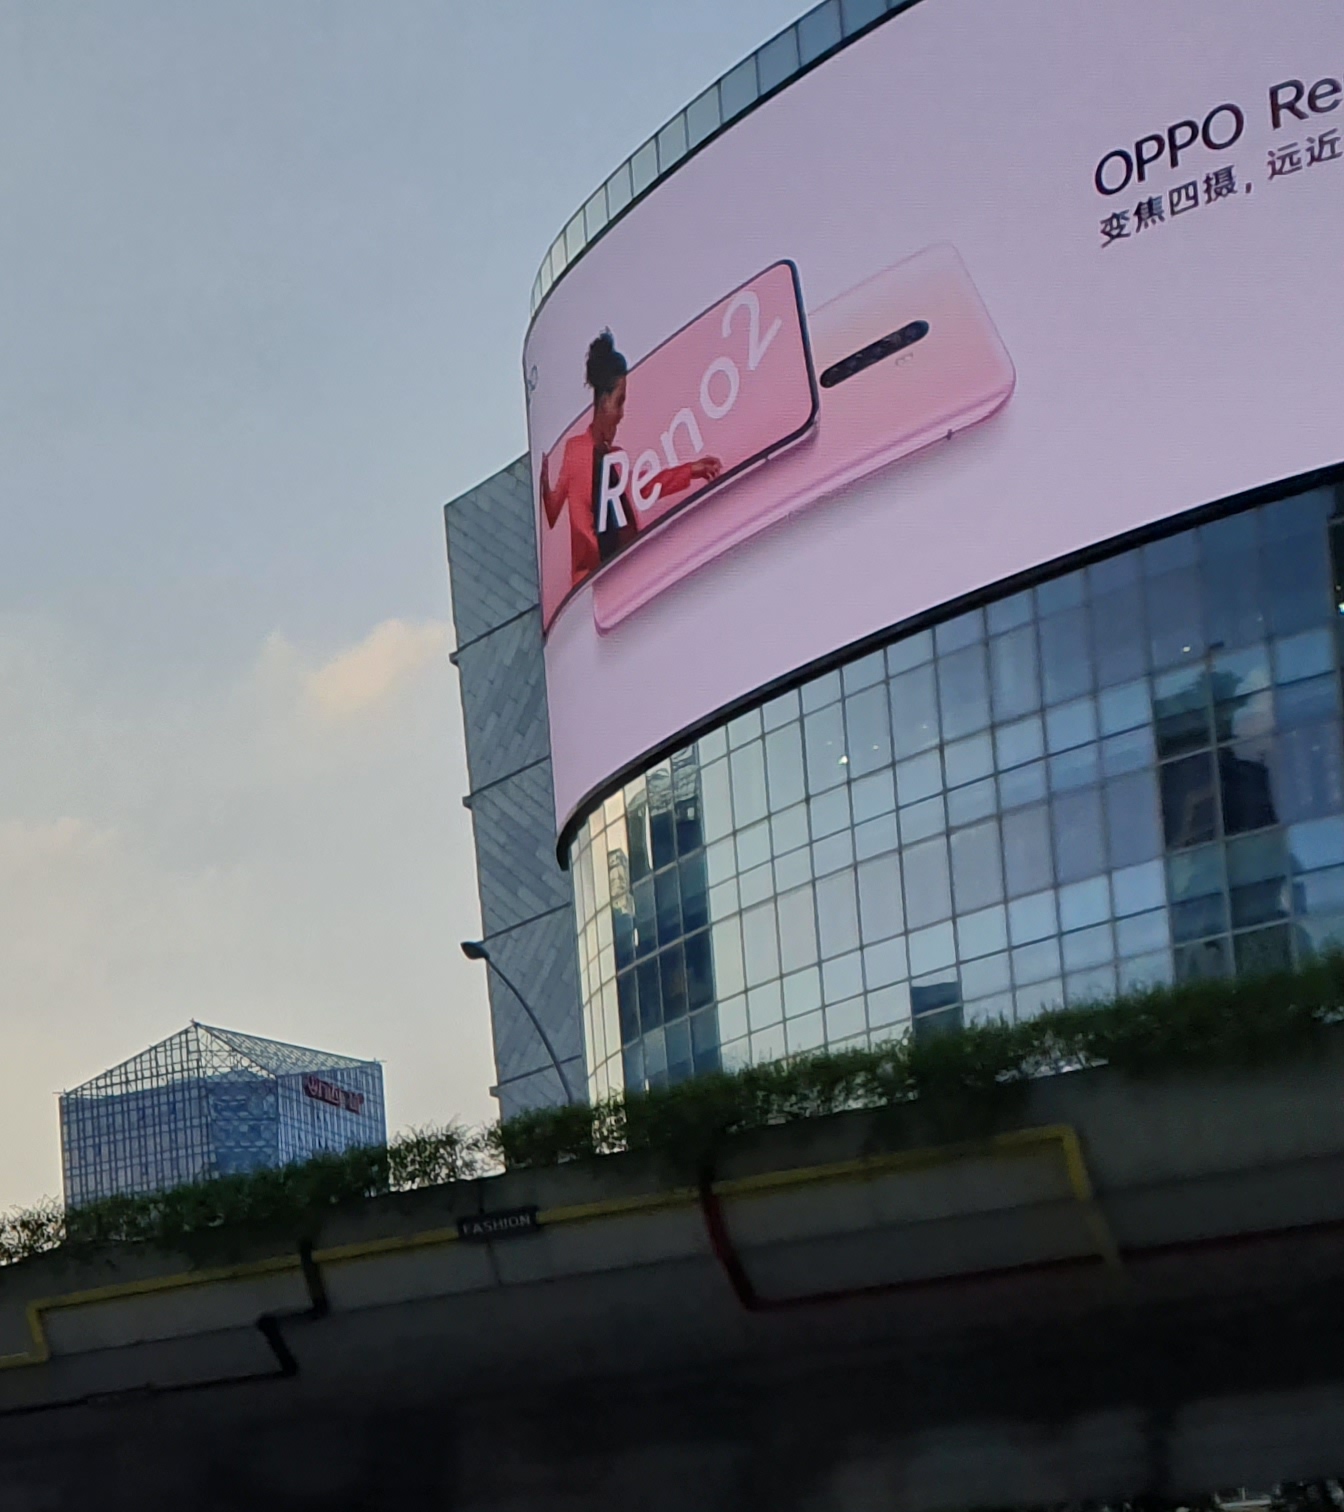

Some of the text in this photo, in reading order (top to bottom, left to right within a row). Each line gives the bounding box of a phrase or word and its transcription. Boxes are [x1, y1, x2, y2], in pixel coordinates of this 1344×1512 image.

[1094, 103, 1245, 196] OPPO
[597, 290, 782, 532] Reno2
[462, 1213, 531, 1235] FASHION
